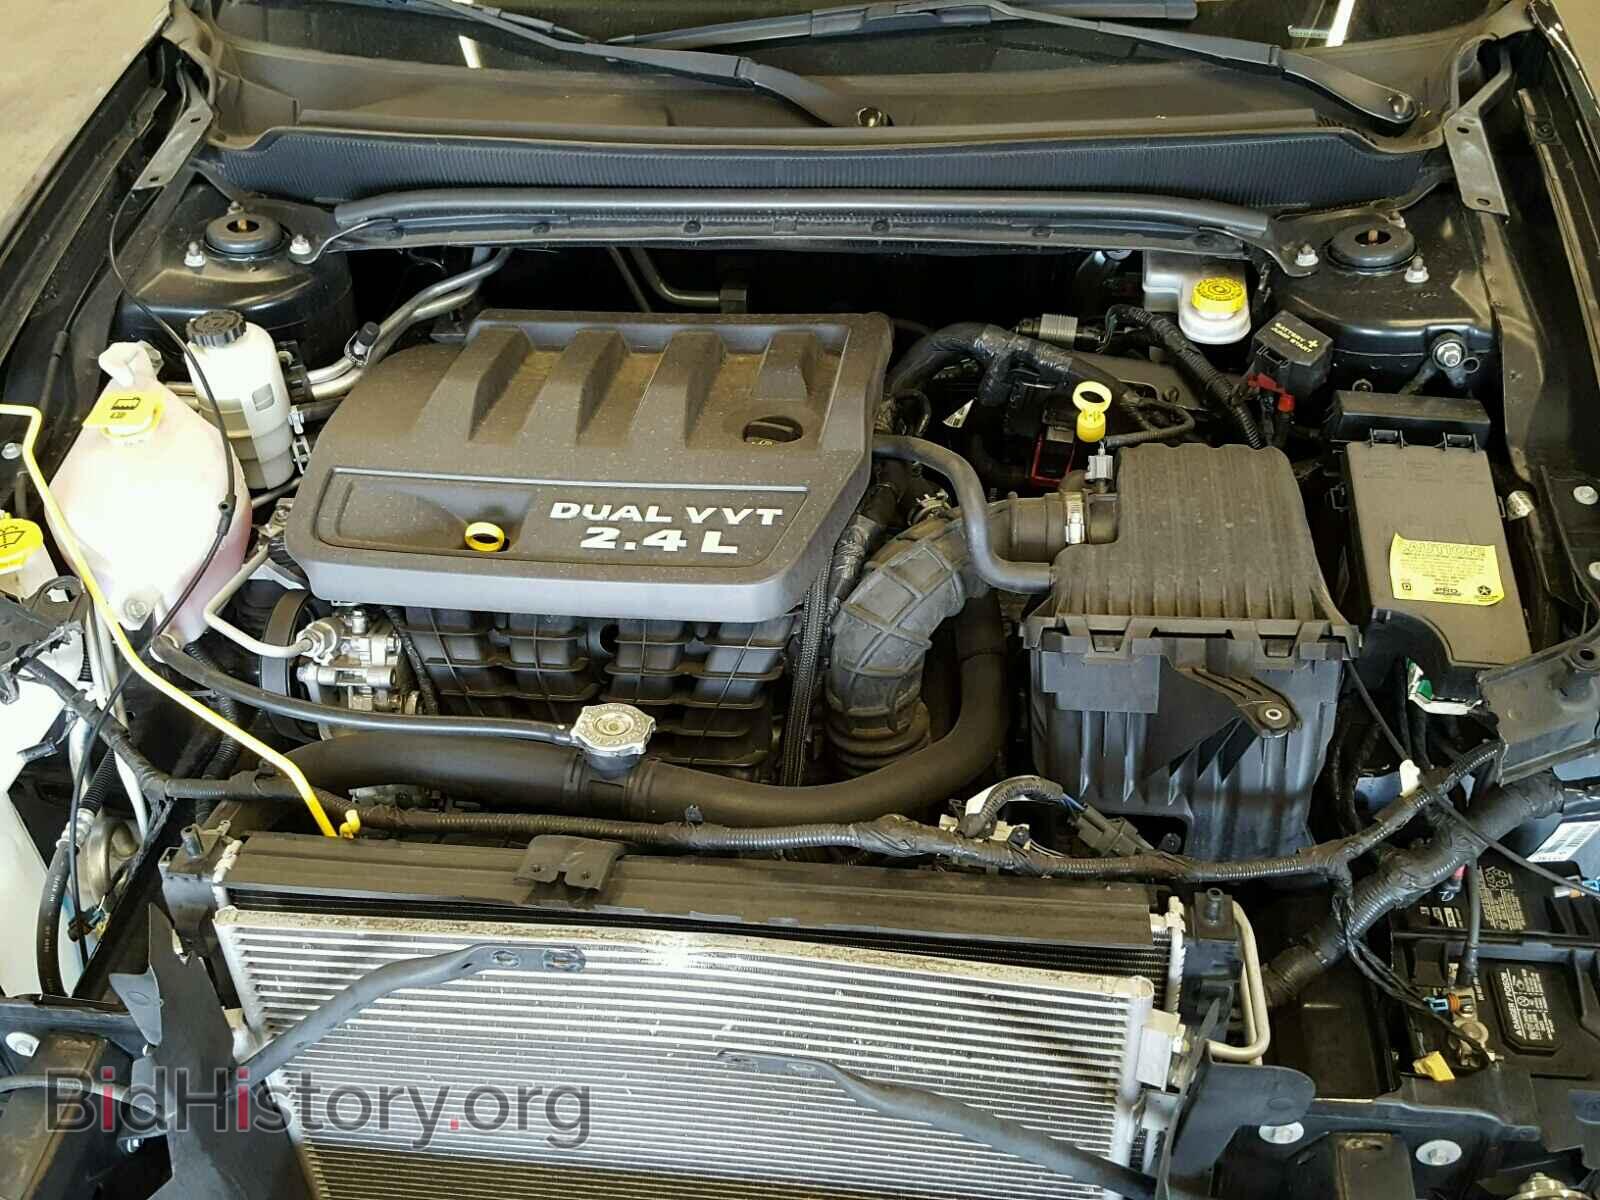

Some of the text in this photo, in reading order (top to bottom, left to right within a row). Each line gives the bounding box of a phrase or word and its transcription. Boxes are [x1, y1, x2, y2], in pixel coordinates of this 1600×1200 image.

[550, 502, 783, 525] DUAL VVT
[580, 527, 738, 554] 2.4 L
